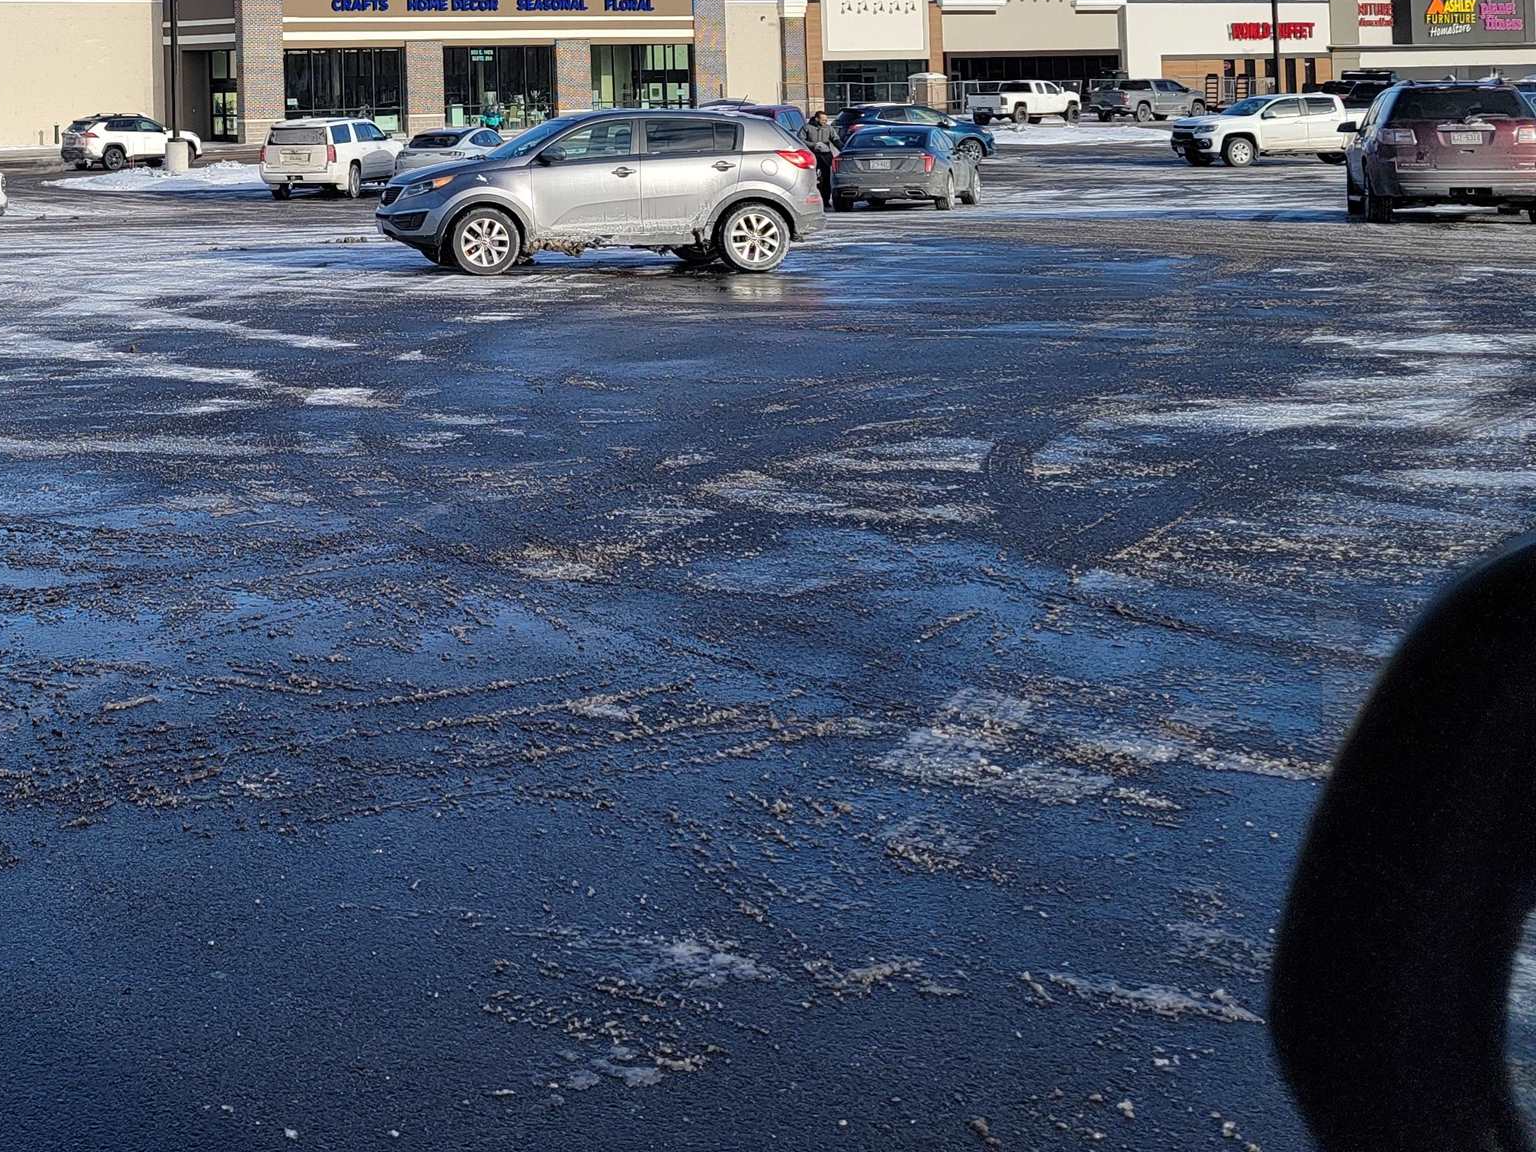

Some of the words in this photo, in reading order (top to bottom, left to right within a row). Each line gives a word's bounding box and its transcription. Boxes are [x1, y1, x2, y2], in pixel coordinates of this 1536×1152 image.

[604, 0, 655, 12] FLORAL
[1444, 0, 1476, 12] ASHLEY
[1426, 14, 1476, 24] FURNITURE
[1228, 22, 1270, 40] WORLD
[1271, 22, 1315, 40] UFFET
